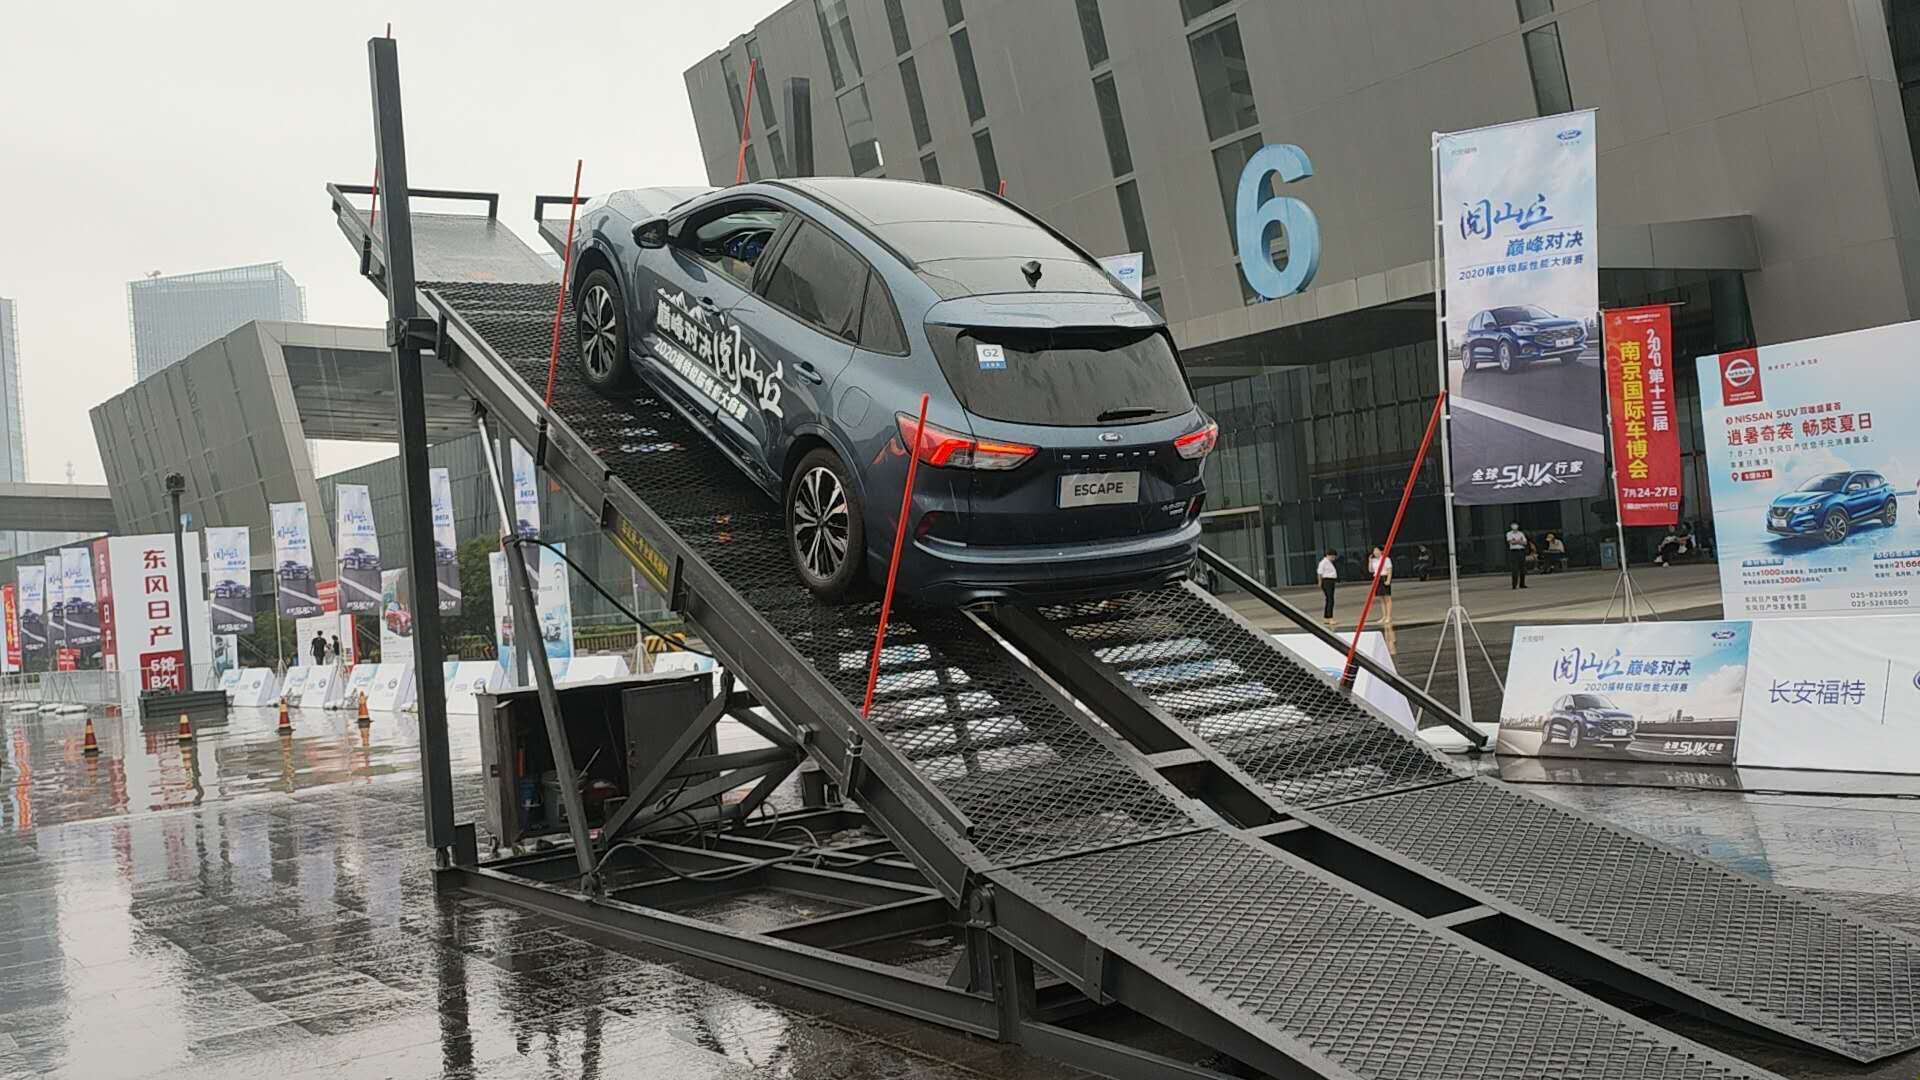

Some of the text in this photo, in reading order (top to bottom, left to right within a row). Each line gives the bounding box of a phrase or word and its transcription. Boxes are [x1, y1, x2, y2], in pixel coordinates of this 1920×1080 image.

[1236, 143, 1322, 299] 6
[1506, 230, 1584, 257] 巅峰对决
[1620, 341, 1648, 479] 南京国际车博会
[1733, 411, 1773, 425] NISSAN
[1802, 412, 1872, 436] 畅爽夏日
[1074, 482, 1124, 497] ESCAPE
[1623, 487, 1677, 498] 7月24-27日
[143, 550, 173, 646] 东风日产
[150, 656, 177, 672] 5馆
[1626, 659, 1692, 677] 巅峰对决
[151, 675, 178, 688] B21
[1768, 679, 1866, 705] 长安福特
